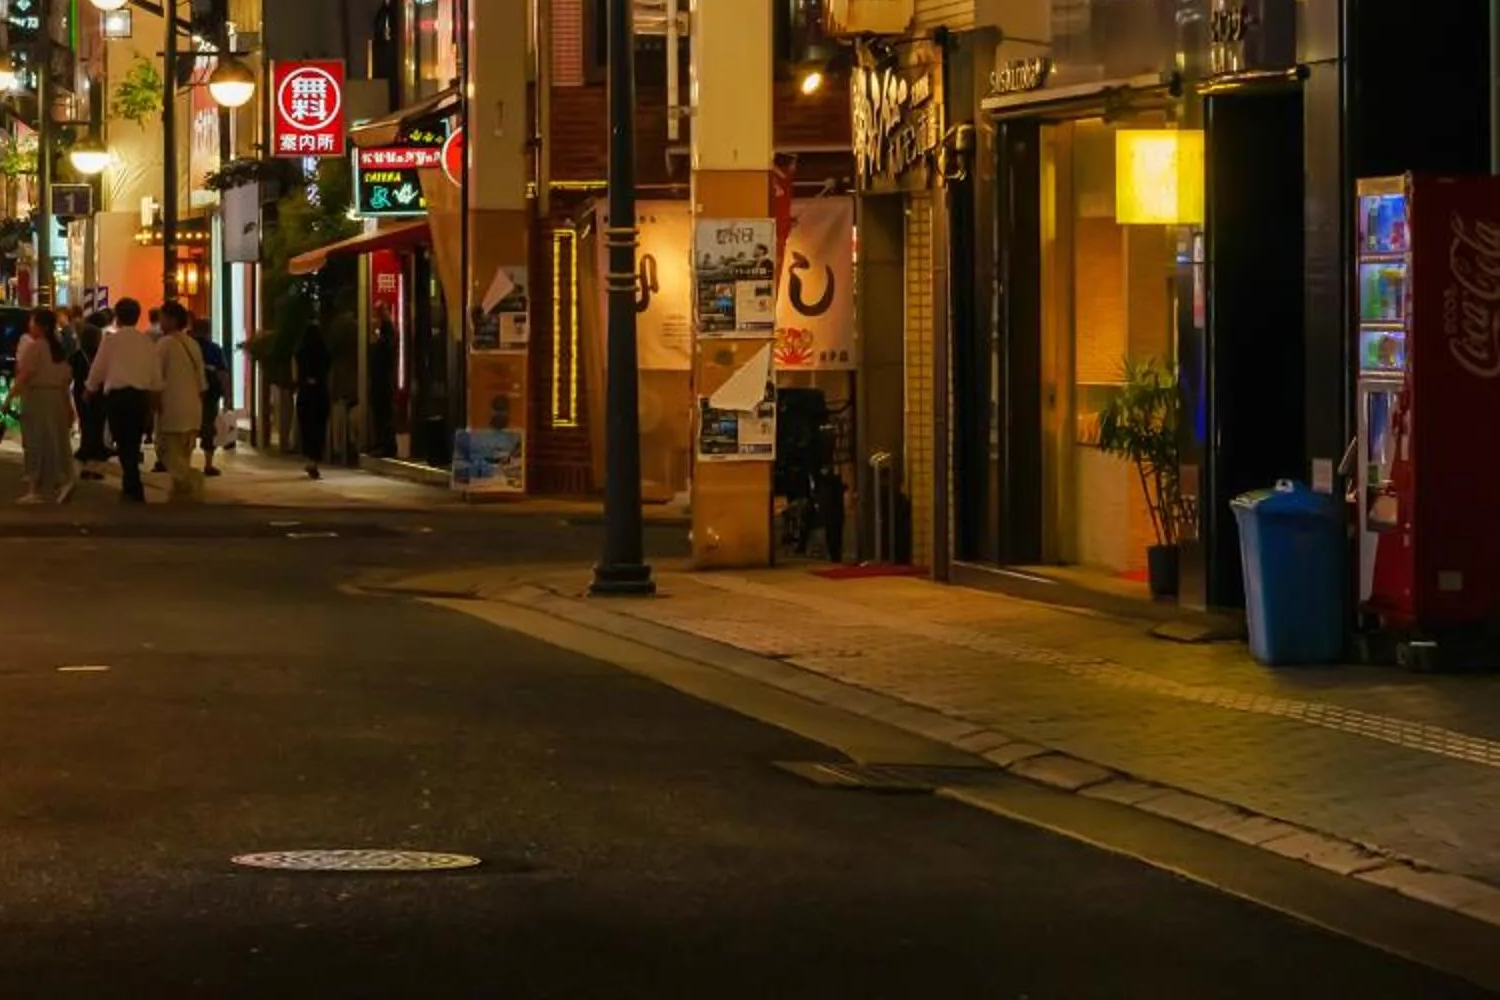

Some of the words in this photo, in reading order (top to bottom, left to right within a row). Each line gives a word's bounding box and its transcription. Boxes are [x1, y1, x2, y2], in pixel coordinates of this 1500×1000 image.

[291, 76, 327, 121] 無料
[279, 132, 334, 151] 案内所
